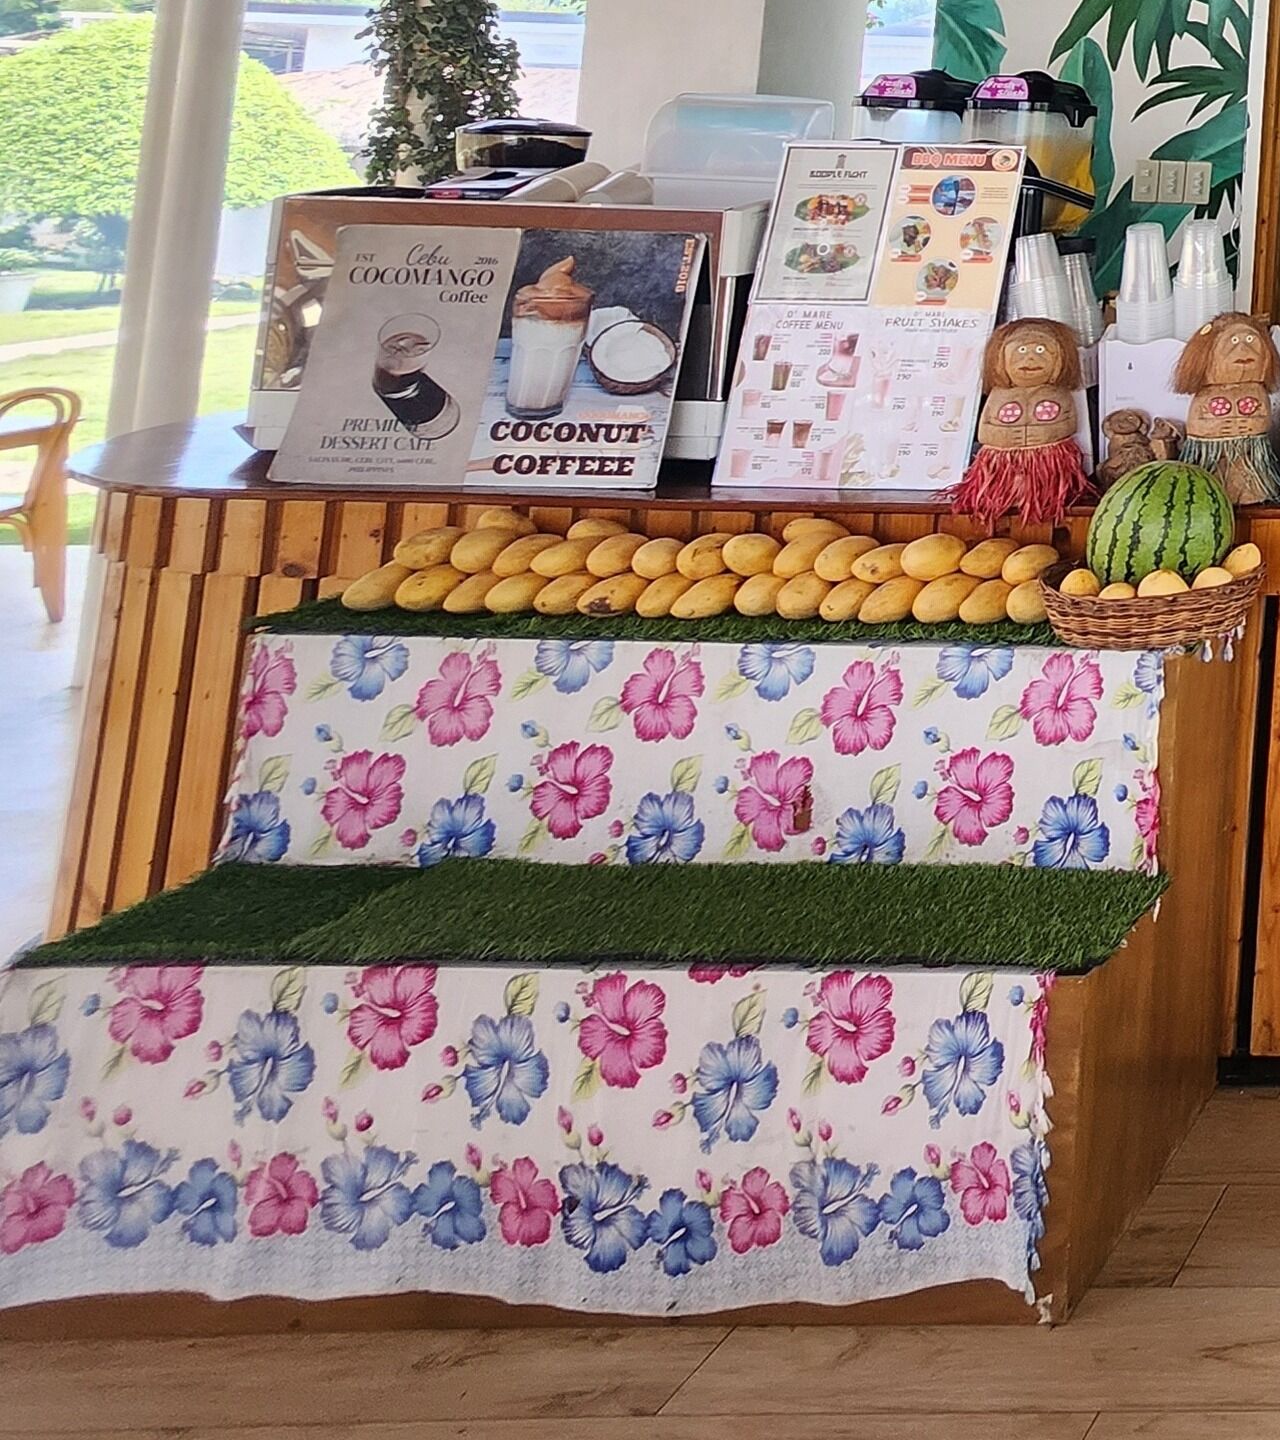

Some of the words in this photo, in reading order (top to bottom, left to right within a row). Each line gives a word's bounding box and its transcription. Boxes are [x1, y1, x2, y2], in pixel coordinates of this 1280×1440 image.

[911, 152, 943, 168] BBQ
[943, 153, 986, 167] MENU
[406, 243, 451, 266] Cebu
[349, 266, 495, 287] COCOMANGO
[439, 289, 489, 304] Coffee
[776, 321, 811, 329] COFFEE
[815, 321, 844, 330] MENU
[885, 317, 923, 327] FRUIT
[929, 318, 979, 328] SHAKES
[490, 421, 647, 443] COCONUT
[320, 436, 390, 450] DESSERT
[492, 454, 636, 476] COFFEEE
